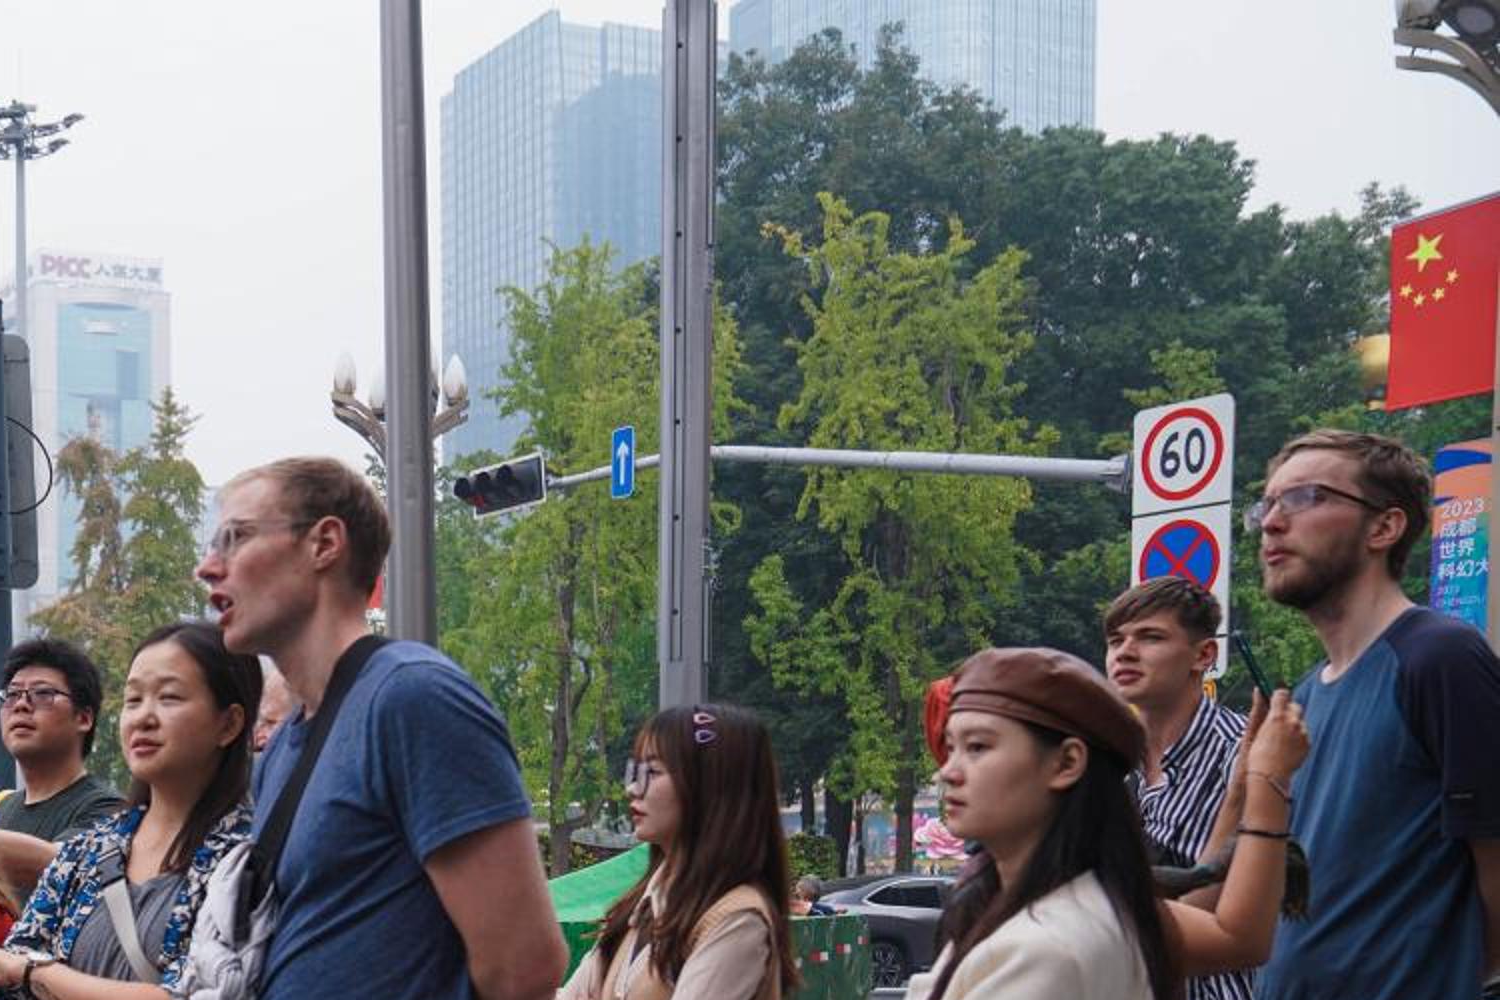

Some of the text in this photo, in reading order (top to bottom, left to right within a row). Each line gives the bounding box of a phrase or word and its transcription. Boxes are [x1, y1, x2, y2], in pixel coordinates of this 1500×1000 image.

[40, 254, 92, 279] PICC
[1160, 427, 1206, 478] 60
[1442, 499, 1485, 519] 2023
[1439, 538, 1476, 559] 世界
[1437, 557, 1490, 579] 科幻大
